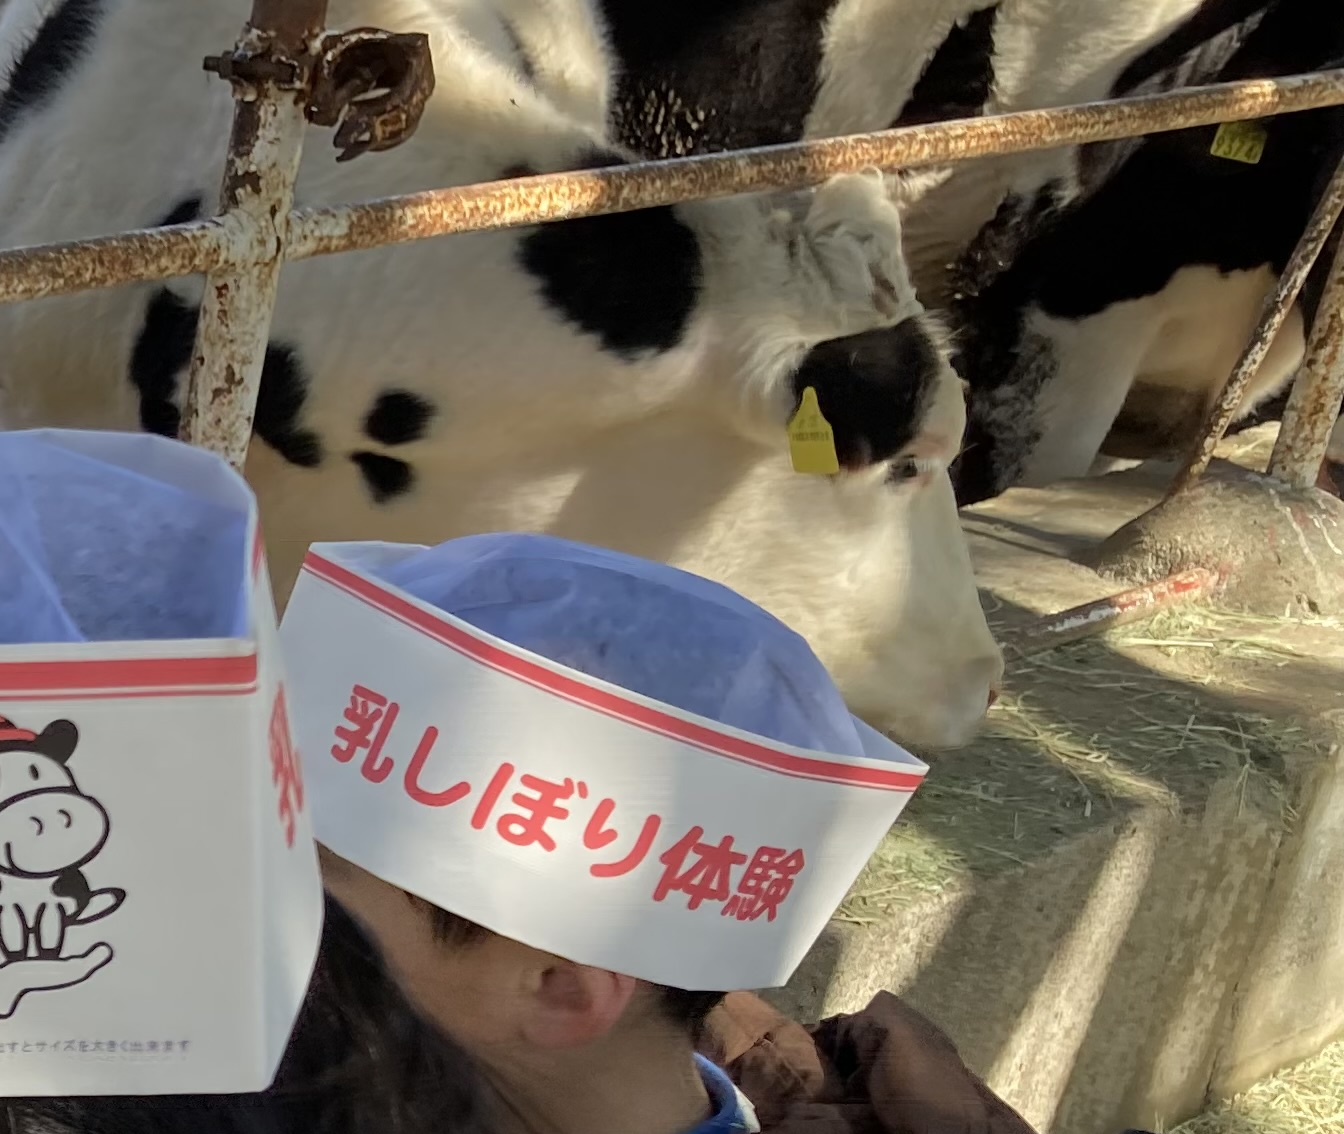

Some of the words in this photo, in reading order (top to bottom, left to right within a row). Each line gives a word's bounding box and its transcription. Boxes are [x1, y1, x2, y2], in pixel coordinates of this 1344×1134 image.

[330, 683, 806, 922] 乳しぼり体験
